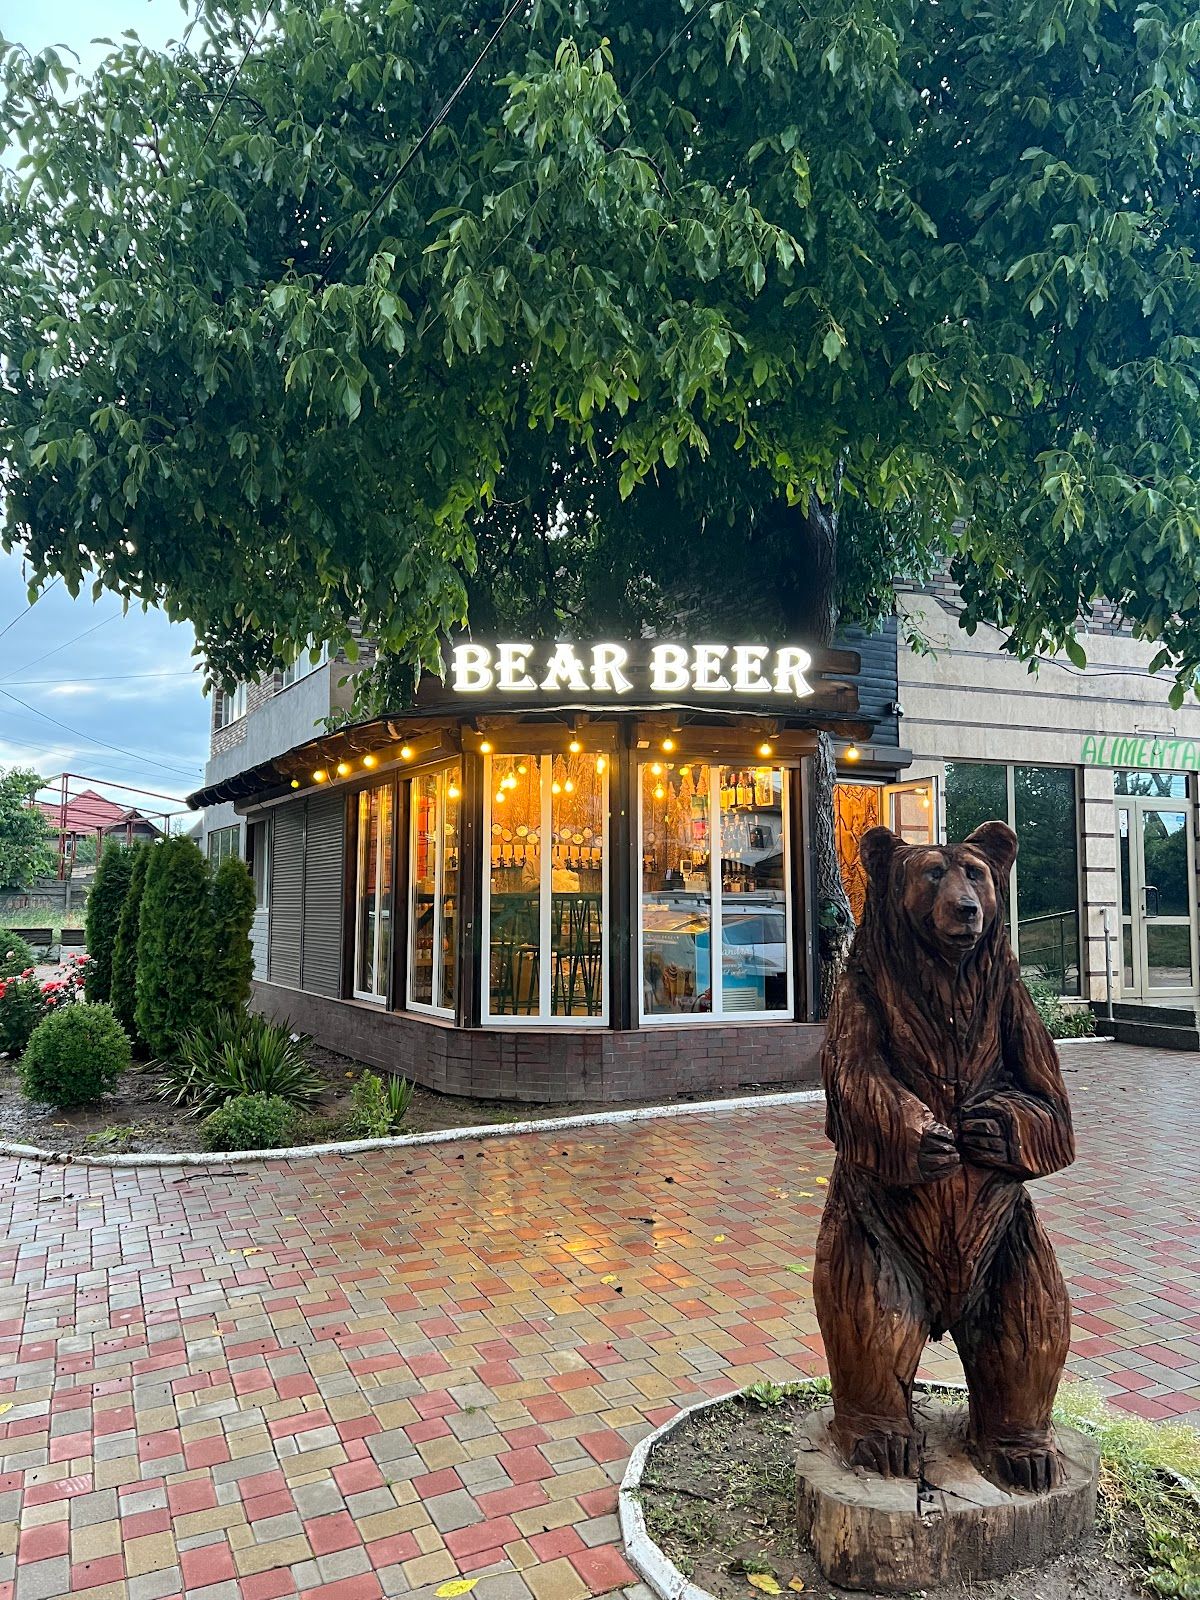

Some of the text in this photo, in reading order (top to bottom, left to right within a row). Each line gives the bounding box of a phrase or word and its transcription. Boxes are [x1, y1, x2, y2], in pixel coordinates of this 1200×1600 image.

[451, 643, 815, 698] BEAR BEER
[1081, 735, 1200, 771] ALIMENTA
